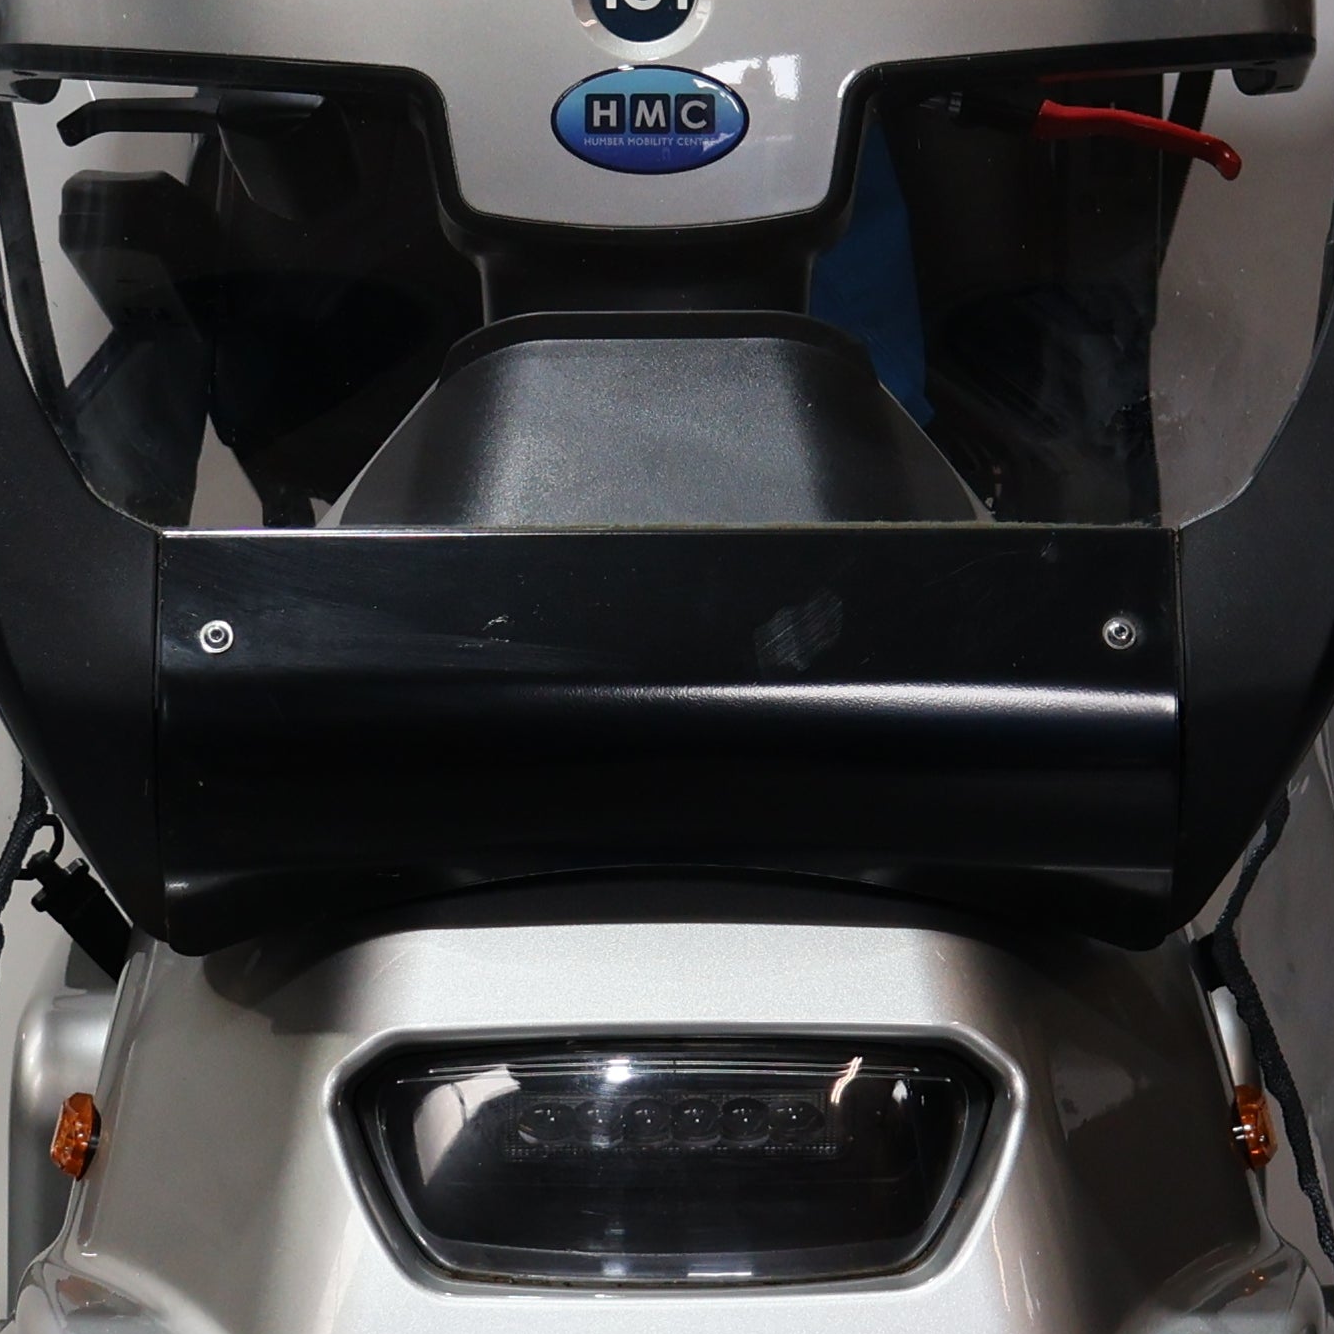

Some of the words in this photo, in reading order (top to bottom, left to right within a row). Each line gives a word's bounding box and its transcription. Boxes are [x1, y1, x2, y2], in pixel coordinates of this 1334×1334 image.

[592, 99, 708, 129] HMC
[584, 137, 624, 146] HUMBER
[627, 137, 673, 146] MOBILITY
